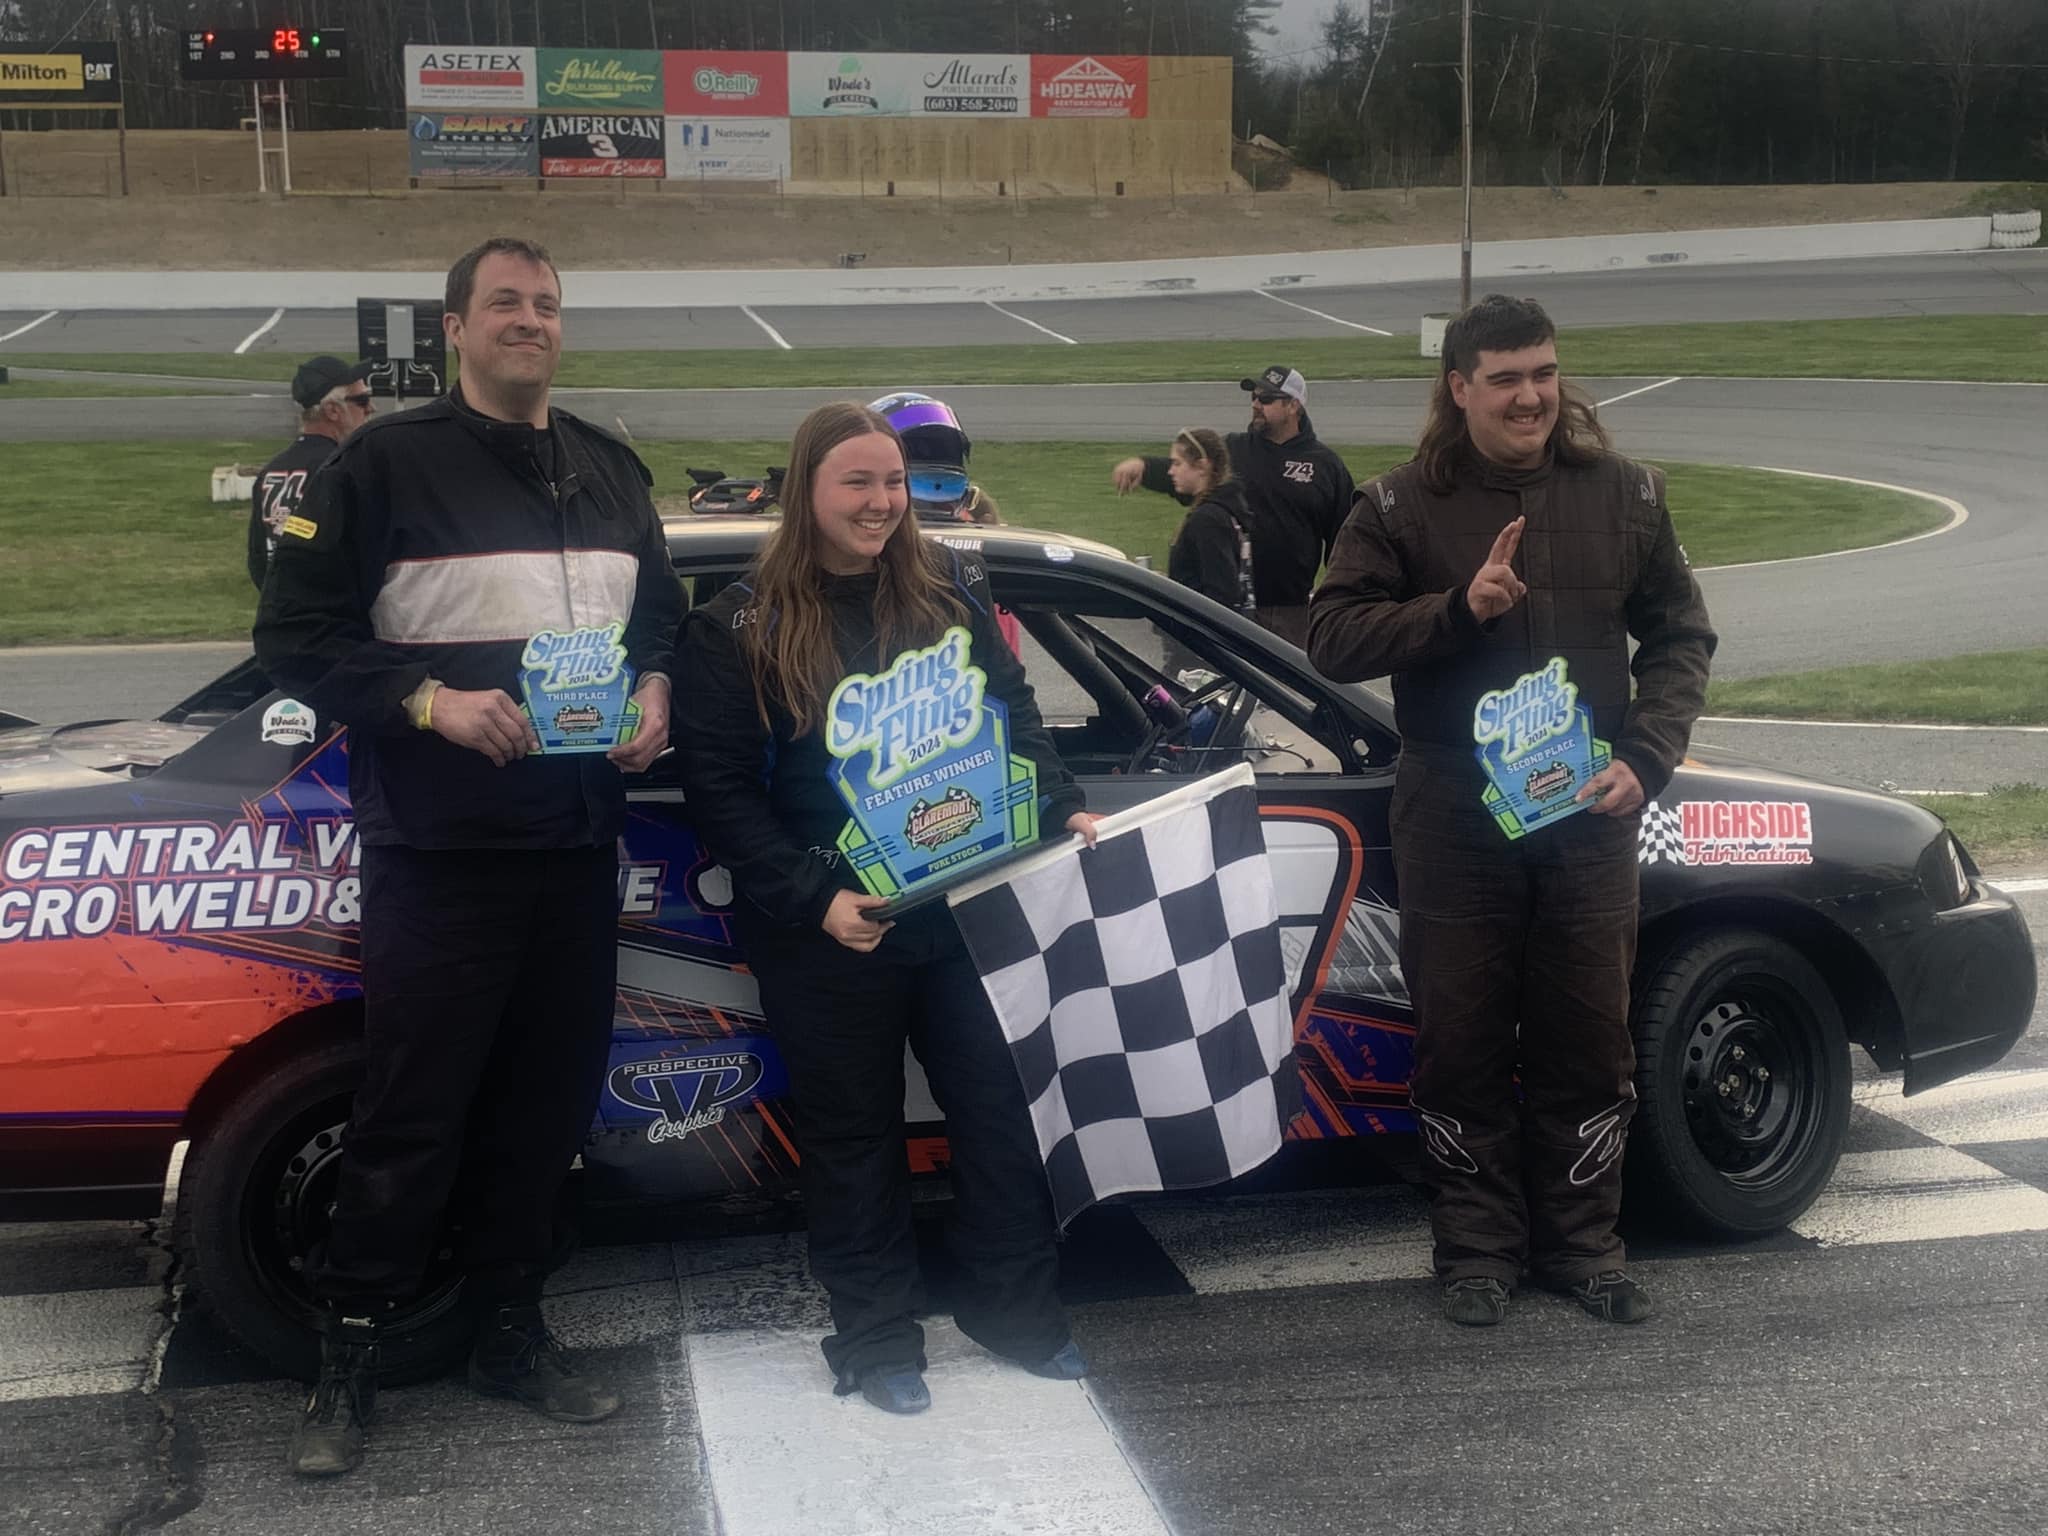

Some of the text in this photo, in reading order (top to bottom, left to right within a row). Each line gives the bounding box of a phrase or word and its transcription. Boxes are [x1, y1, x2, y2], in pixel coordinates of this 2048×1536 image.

[275, 31, 300, 50] 25
[2, 64, 67, 80] Milton
[85, 63, 114, 80] CAT
[421, 53, 521, 70] ASETEX
[923, 59, 1018, 89] Allard's
[695, 69, 760, 95] O'Reilly
[1041, 83, 1136, 98] HIDEAWAY
[926, 98, 958, 111] (603)
[541, 115, 661, 140] AMERICAN
[715, 128, 771, 138] Nationwide
[587, 134, 619, 157] 3
[526, 624, 617, 664] Spring
[546, 649, 618, 686] Fling
[546, 691, 609, 701] THIRD PLACE
[834, 634, 960, 748] Spring
[1478, 661, 1559, 737] Spring
[876, 673, 974, 776] Fling
[1504, 689, 1570, 756] Fling
[908, 735, 942, 764] 2024
[1506, 738, 1576, 774] SECOND PLACE
[864, 749, 995, 812] FEATURE WINNER
[911, 797, 972, 835] CLAREMONT
[1682, 803, 1810, 840] HIGHSIDE
[5, 823, 361, 880] CENTRAL V
[928, 843, 983, 872] PURE STOCKS
[1685, 841, 1812, 864] Fabrication
[0, 866, 661, 939] CRO WELD & E
[623, 1054, 750, 1076] PERSPECTIVE
[648, 1105, 727, 1143] Graphics
